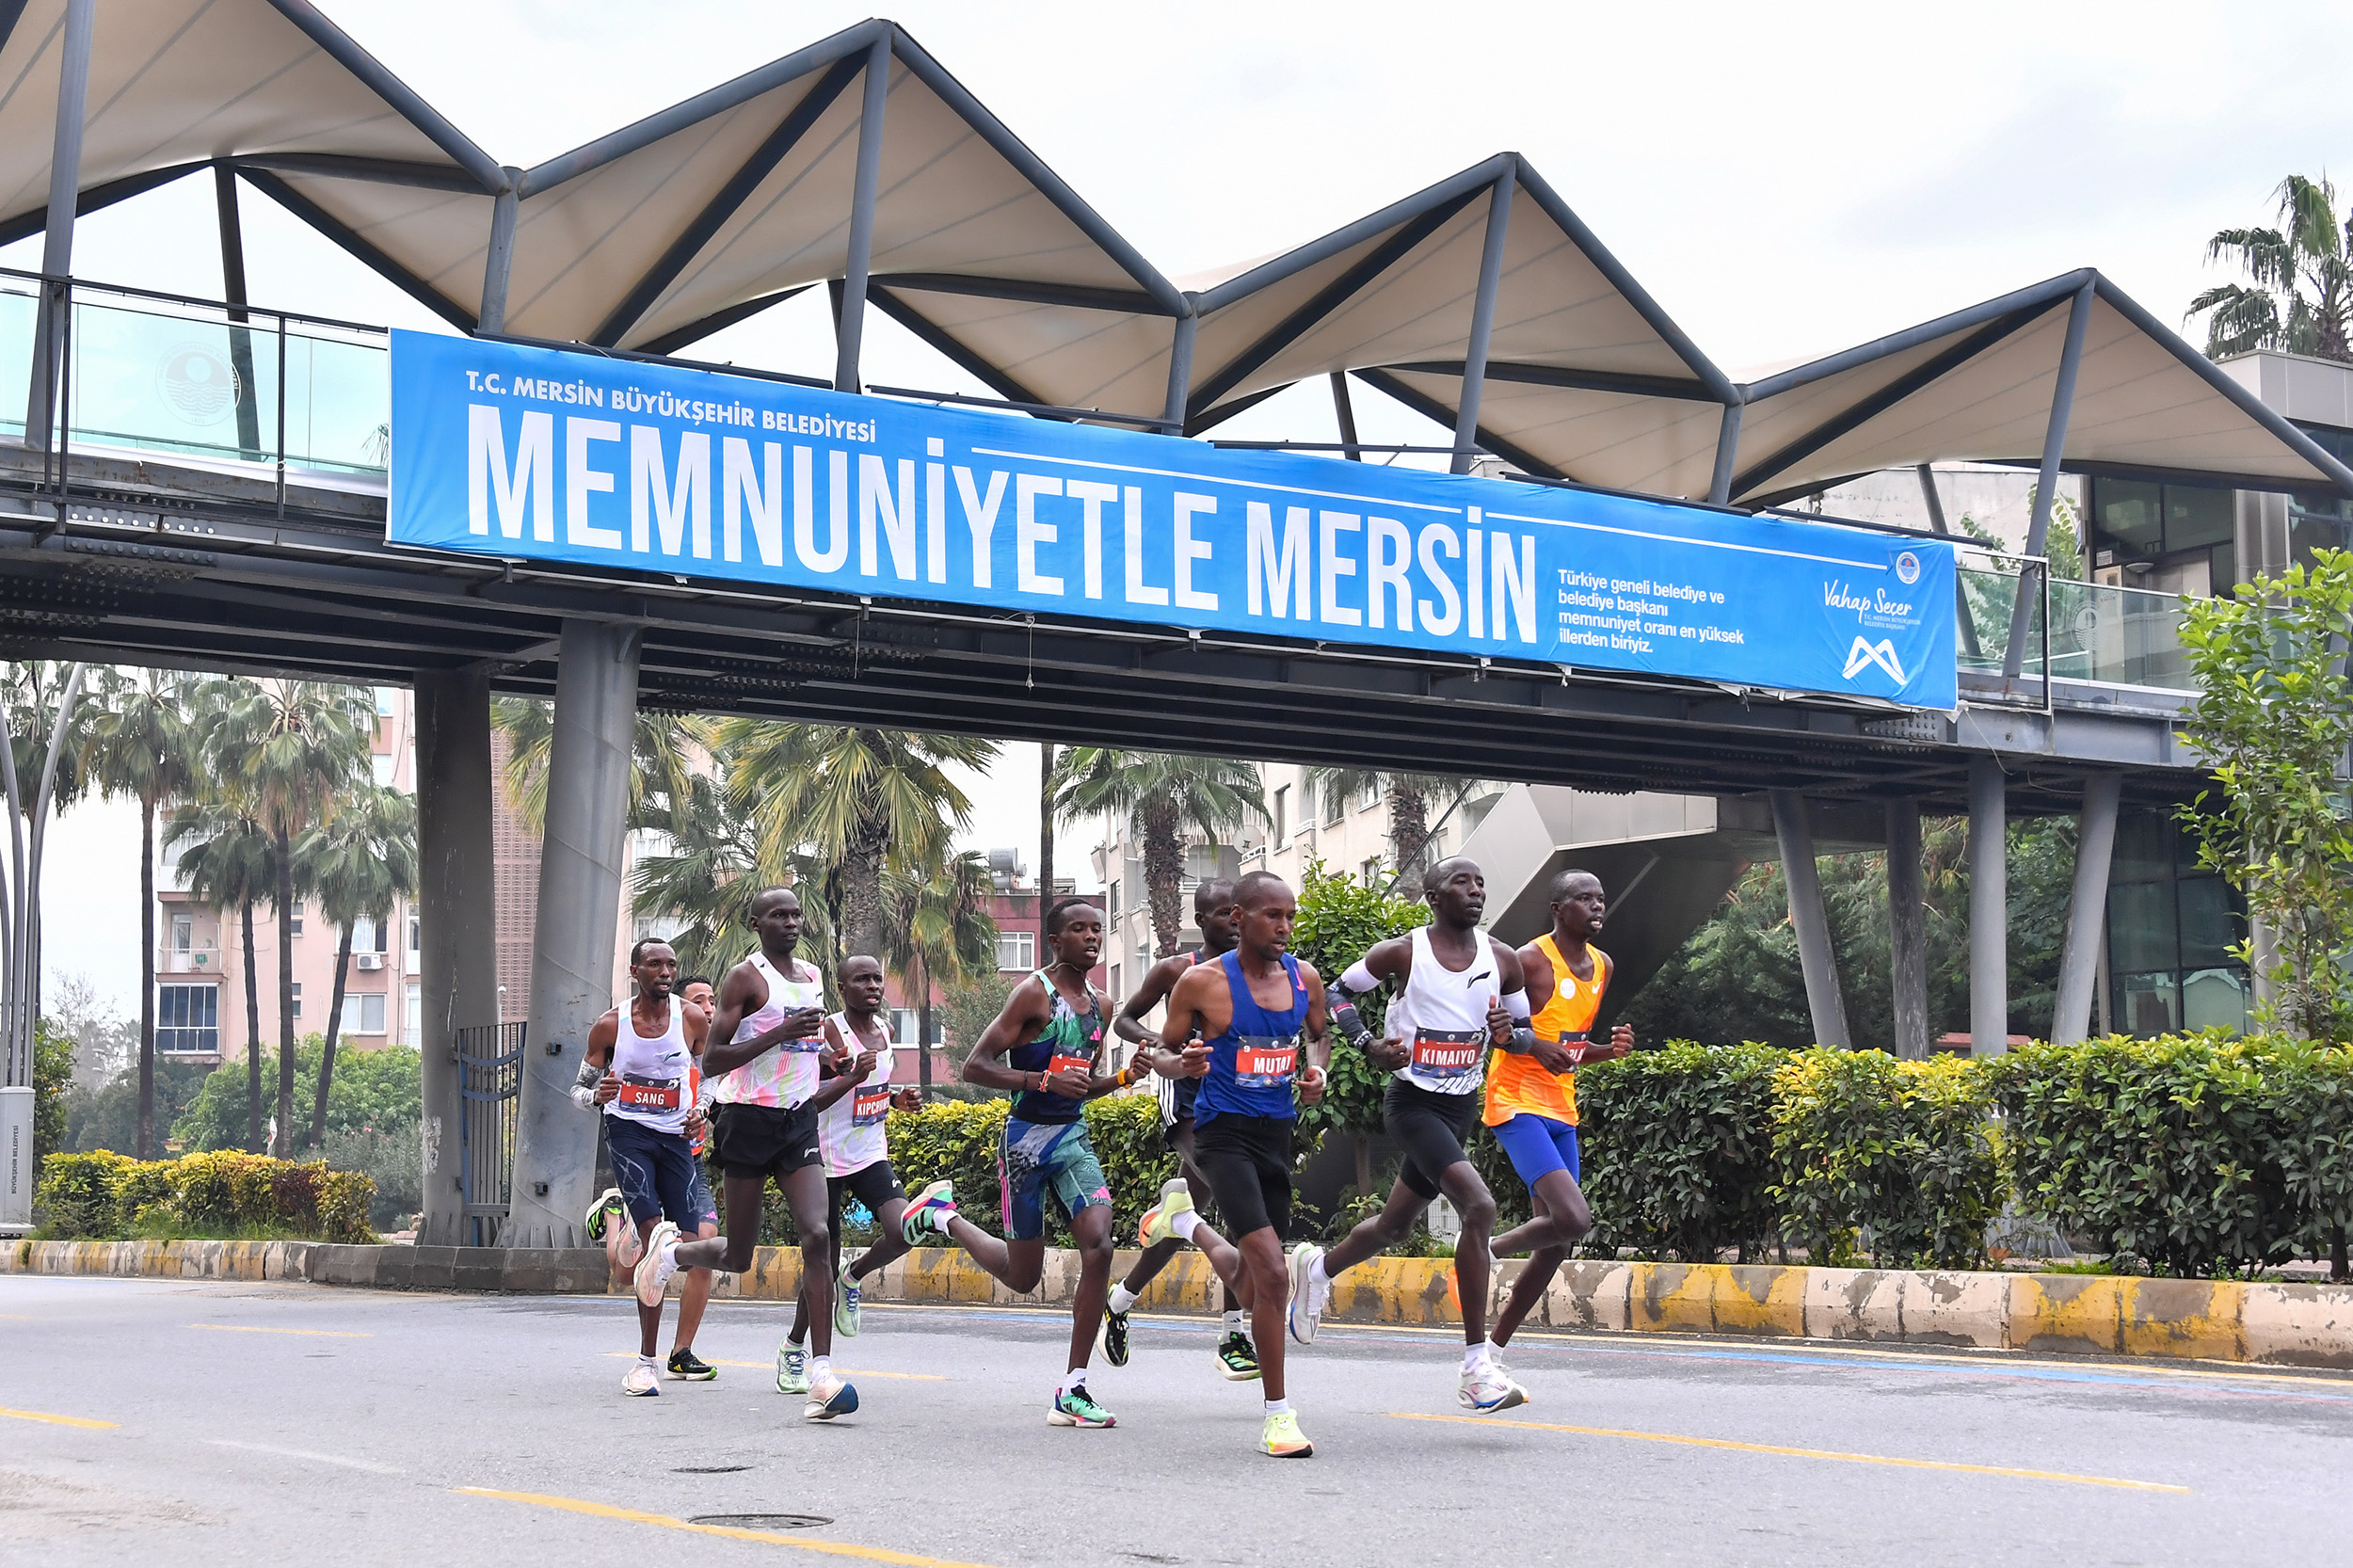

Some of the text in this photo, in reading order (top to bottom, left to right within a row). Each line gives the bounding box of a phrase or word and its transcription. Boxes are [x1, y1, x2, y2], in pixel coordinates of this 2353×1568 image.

[466, 370, 876, 445] T.C. MERSİN BÜYÜKŞEHİR BELEDİYESİ
[468, 403, 1537, 644] MEMNUNİYETLE MERSİN
[1557, 568, 1725, 604] Türkiye geneli belediye ve
[1558, 588, 1669, 617] belediye başkanı
[1824, 579, 1913, 624] Vahap Seçer
[1559, 612, 1745, 645] memnuniyet oranı en yüksek
[1559, 627, 1654, 654] illerden biriyiz.
[1243, 1045, 1251, 1053] 9
[1420, 1048, 1476, 1065] KIMAIYO
[1253, 1055, 1291, 1074] MUTAI
[634, 1091, 665, 1106] SANG
